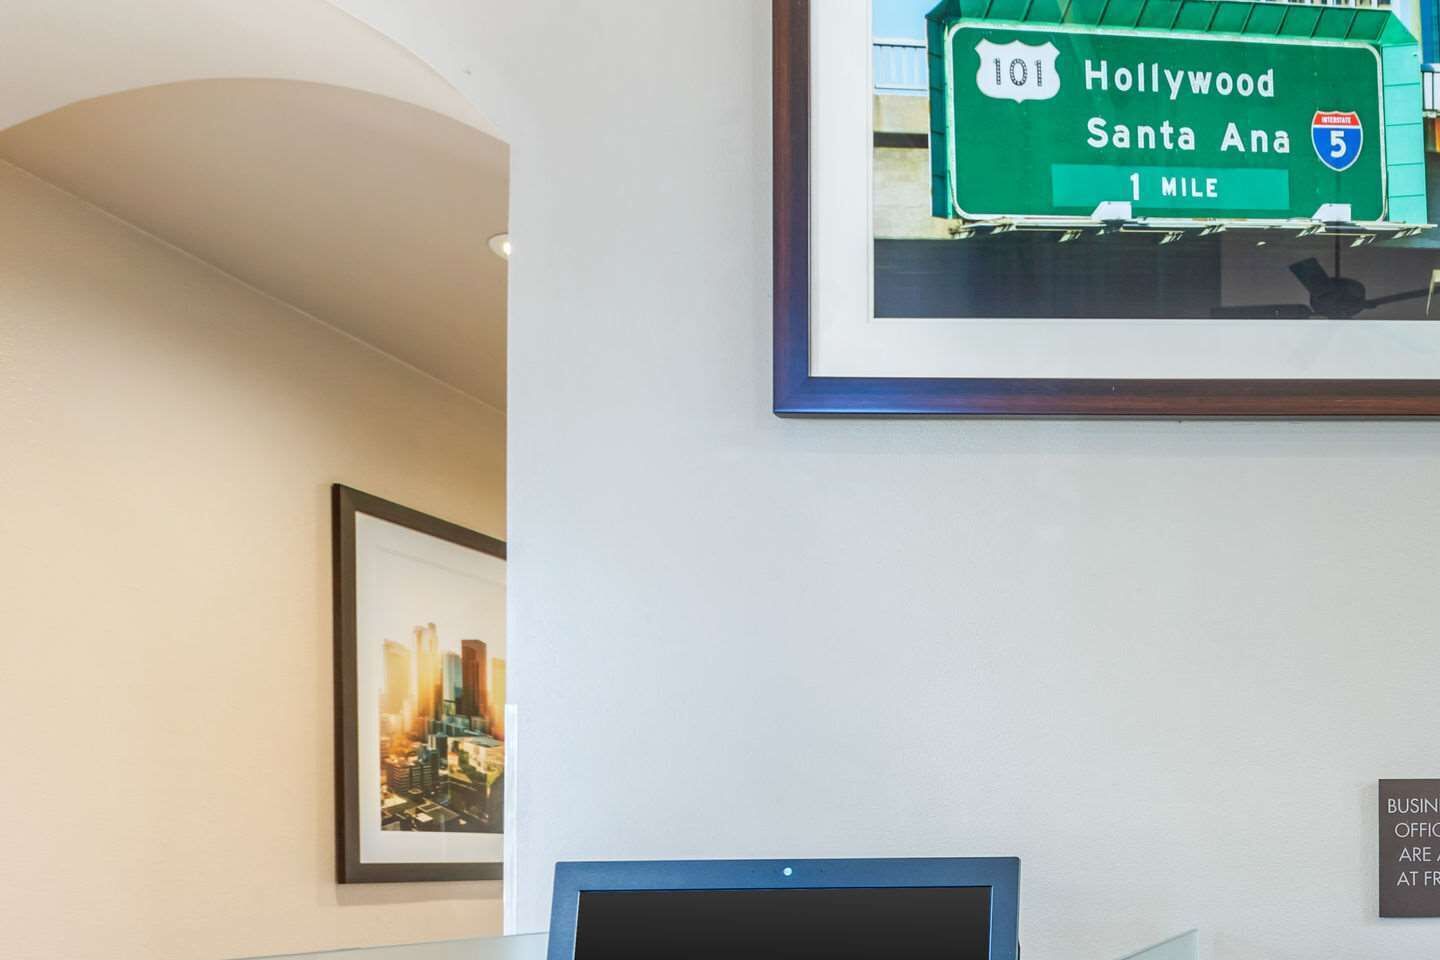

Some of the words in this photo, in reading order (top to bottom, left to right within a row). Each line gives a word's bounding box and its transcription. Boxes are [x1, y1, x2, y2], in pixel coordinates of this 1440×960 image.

[992, 57, 1043, 88] 101
[1084, 59, 1275, 100] Hollywood
[1321, 115, 1352, 125] INTERSTATE
[1087, 117, 1196, 151] Santa
[1220, 122, 1291, 154] Ana
[1329, 131, 1347, 158] 5
[1130, 173, 1140, 201] 1
[1161, 176, 1218, 199] MILE
[1398, 847, 1432, 862] ARE
[1396, 871, 1418, 886] AT
